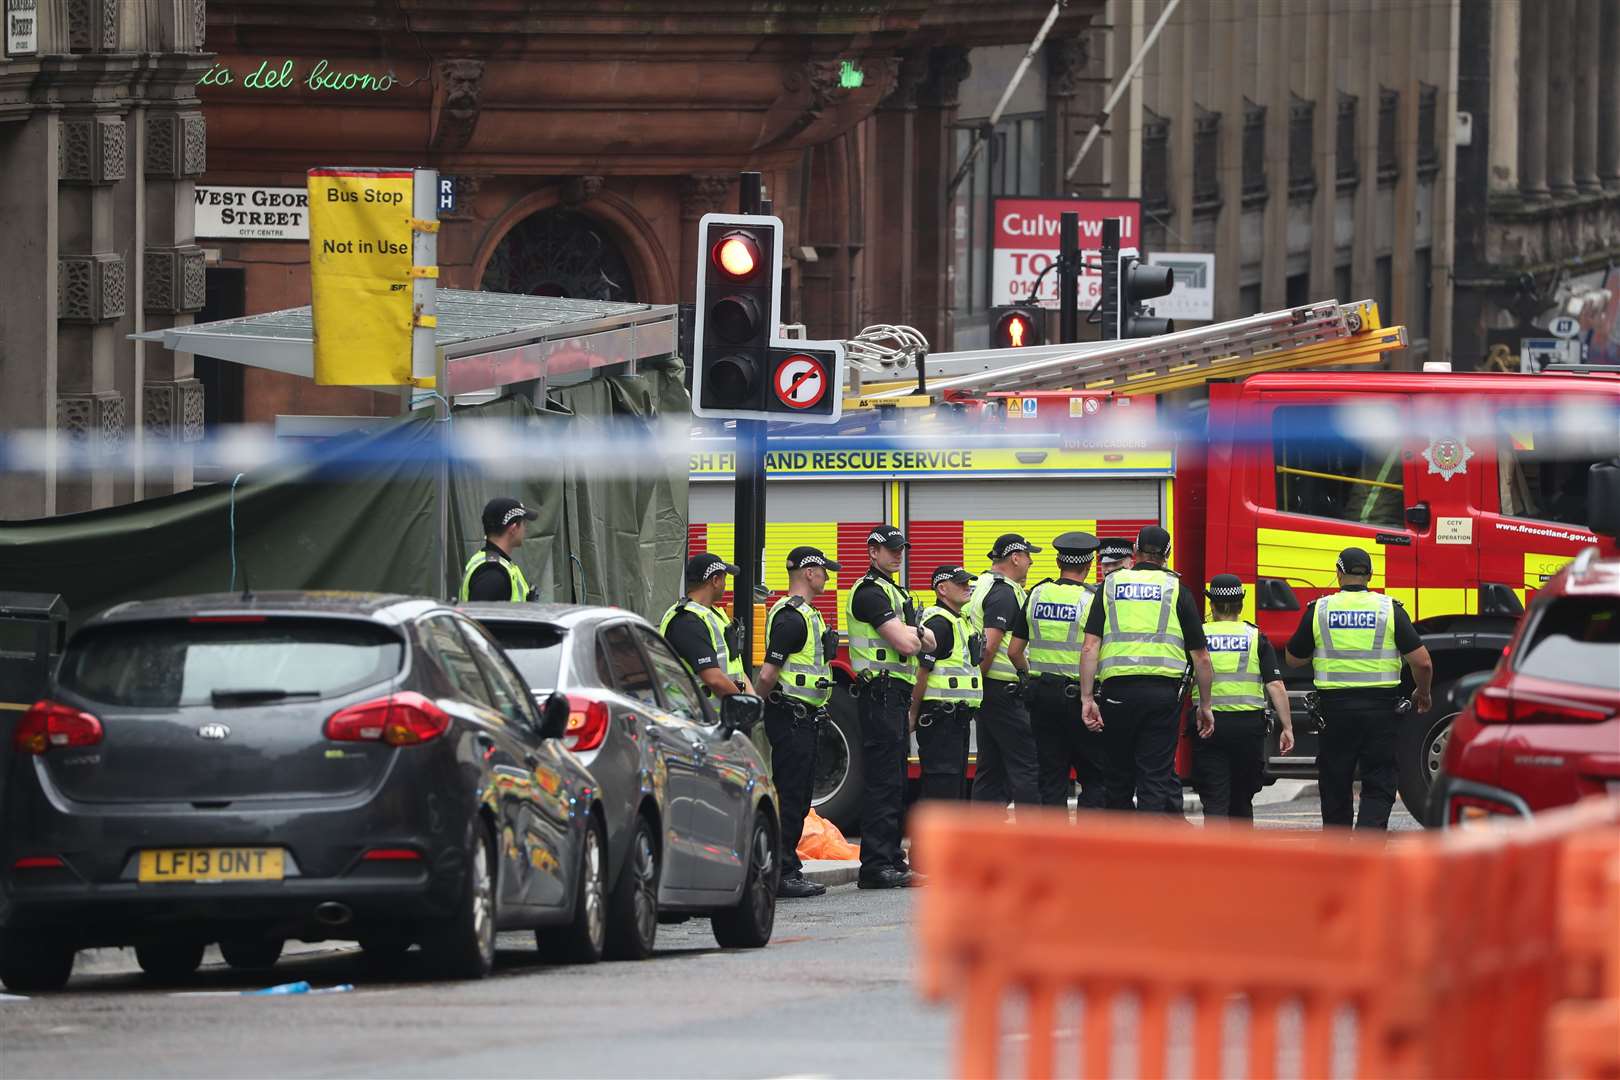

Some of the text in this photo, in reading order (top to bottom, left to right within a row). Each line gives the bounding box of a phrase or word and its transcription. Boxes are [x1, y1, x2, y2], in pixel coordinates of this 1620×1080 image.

[244, 60, 293, 89] del
[305, 60, 398, 91] buono
[195, 190, 246, 206] WEST
[327, 188, 403, 206] Bus Stop
[221, 208, 302, 226] STREET
[1003, 213, 1132, 238] Culvwll
[323, 240, 408, 254] Not in Use
[1010, 254, 1052, 276] TO
[1010, 280, 1043, 296] 0141
[689, 453, 713, 471] SH
[766, 453, 807, 470] AND
[813, 452, 887, 469] RESCUE
[892, 451, 972, 468] SERVICE
[1496, 522, 1599, 543] www.firescotland.gov.uk
[1117, 584, 1161, 599] POLICE
[1036, 603, 1077, 619] POLICE
[1330, 612, 1375, 627] POLICE
[1206, 636, 1247, 650] POLICE
[155, 850, 267, 875] LF13 ONT
